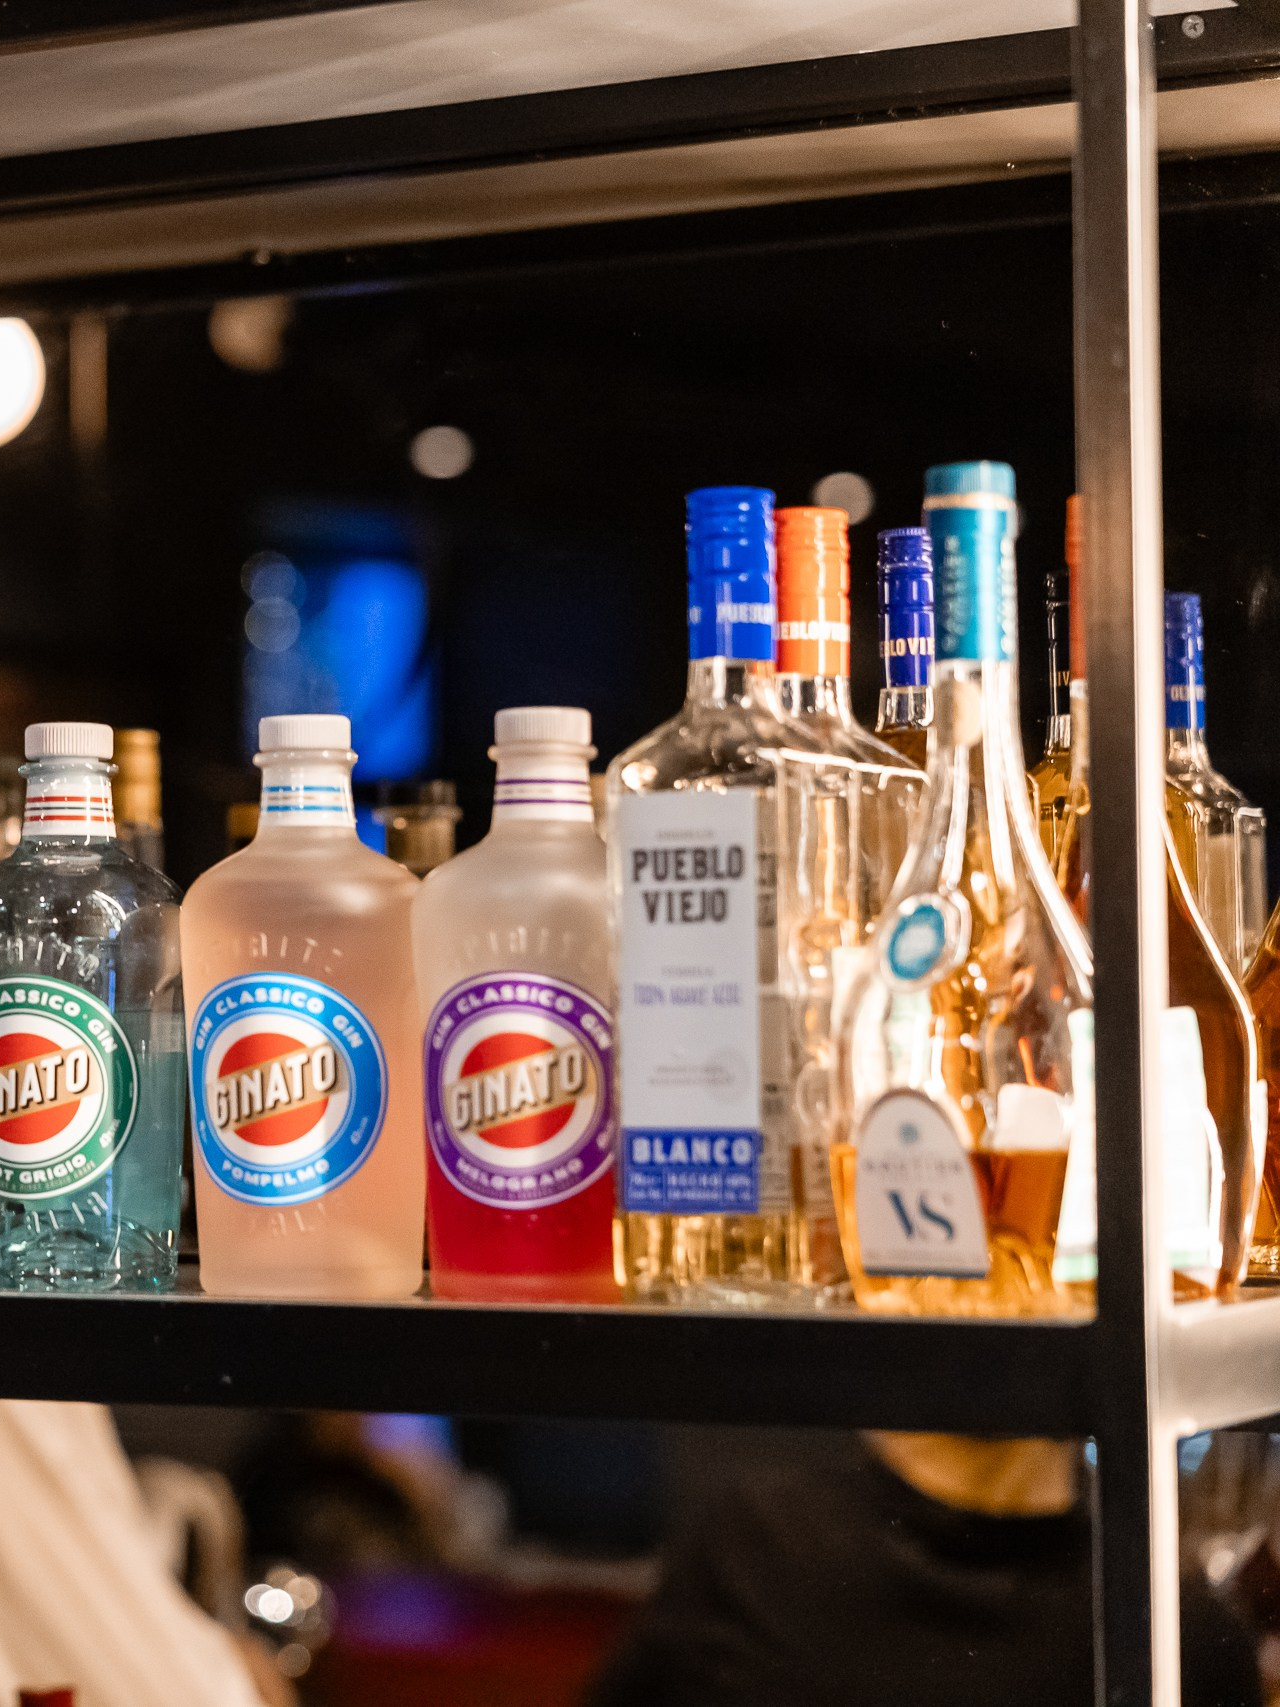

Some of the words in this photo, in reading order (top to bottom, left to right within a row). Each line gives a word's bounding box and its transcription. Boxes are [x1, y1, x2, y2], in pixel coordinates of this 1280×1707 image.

[907, 637, 935, 656] VIE
[630, 844, 746, 882] PUEBLO
[642, 889, 728, 924] VIEJO
[456, 984, 574, 1015] CLASSICO
[195, 1016, 213, 1050] GIN
[215, 987, 325, 1015] CLASSICO
[332, 1014, 364, 1048] GIN
[88, 1019, 119, 1054] GIN
[214, 1046, 337, 1129] GINATO
[451, 1045, 587, 1130] GINATO
[19, 1153, 87, 1184] GRIGIO
[631, 1137, 752, 1165] BLANCO
[222, 1158, 330, 1188] POMPELMO
